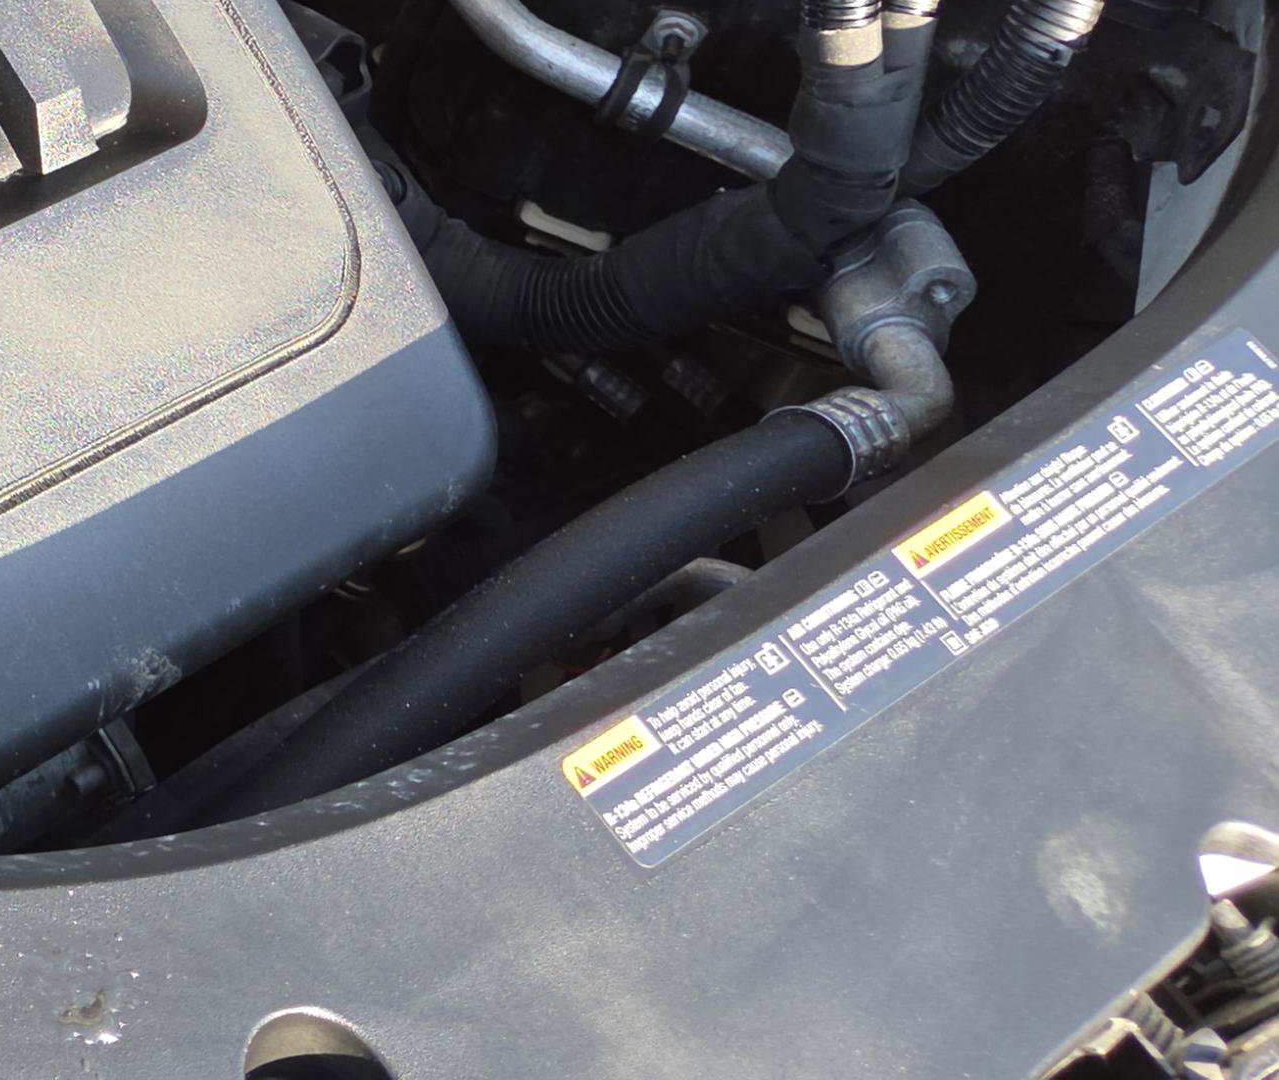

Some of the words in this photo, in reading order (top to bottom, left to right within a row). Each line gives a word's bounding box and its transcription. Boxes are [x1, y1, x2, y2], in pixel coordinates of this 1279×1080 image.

[923, 506, 996, 558] AVERTISSEMENT
[798, 639, 820, 655] Use
[815, 629, 837, 646] only
[828, 612, 862, 636] R-134a
[854, 586, 900, 619] Refrigerant
[893, 577, 914, 595] and
[853, 618, 881, 640] Glycol
[876, 609, 891, 626] oil
[821, 665, 843, 681] The
[838, 649, 868, 672] system
[863, 629, 898, 655] contains
[833, 670, 867, 695] System
[885, 640, 909, 659] 0.65
[901, 635, 921, 649] kg
[645, 716, 663, 730] To
[656, 705, 680, 723] help
[675, 689, 702, 712] avoid
[695, 668, 733, 701] personal
[726, 657, 757, 679] injury,
[656, 723, 683, 745] keep
[675, 707, 706, 730] hands
[701, 694, 725, 714] clear
[720, 686, 734, 702] of
[590, 734, 645, 775] WARNING
[664, 741, 681, 755] It
[675, 733, 695, 750] can
[690, 719, 714, 741] start
[708, 714, 725, 729] at
[717, 706, 737, 723] any
[729, 695, 757, 713] time.
[614, 812, 649, 840] System
[643, 807, 659, 820] to
[652, 799, 671, 814] be
[665, 774, 704, 806] serviced
[696, 770, 714, 784] by
[709, 746, 746, 778] qualified
[740, 722, 782, 758] personnel
[776, 714, 801, 732] only.
[624, 822, 666, 854] Improper
[662, 803, 695, 830] service
[690, 781, 729, 811] methods
[723, 769, 747, 788] may
[741, 754, 768, 776] cause
[763, 731, 800, 764] personal
[792, 718, 823, 741] injury.
